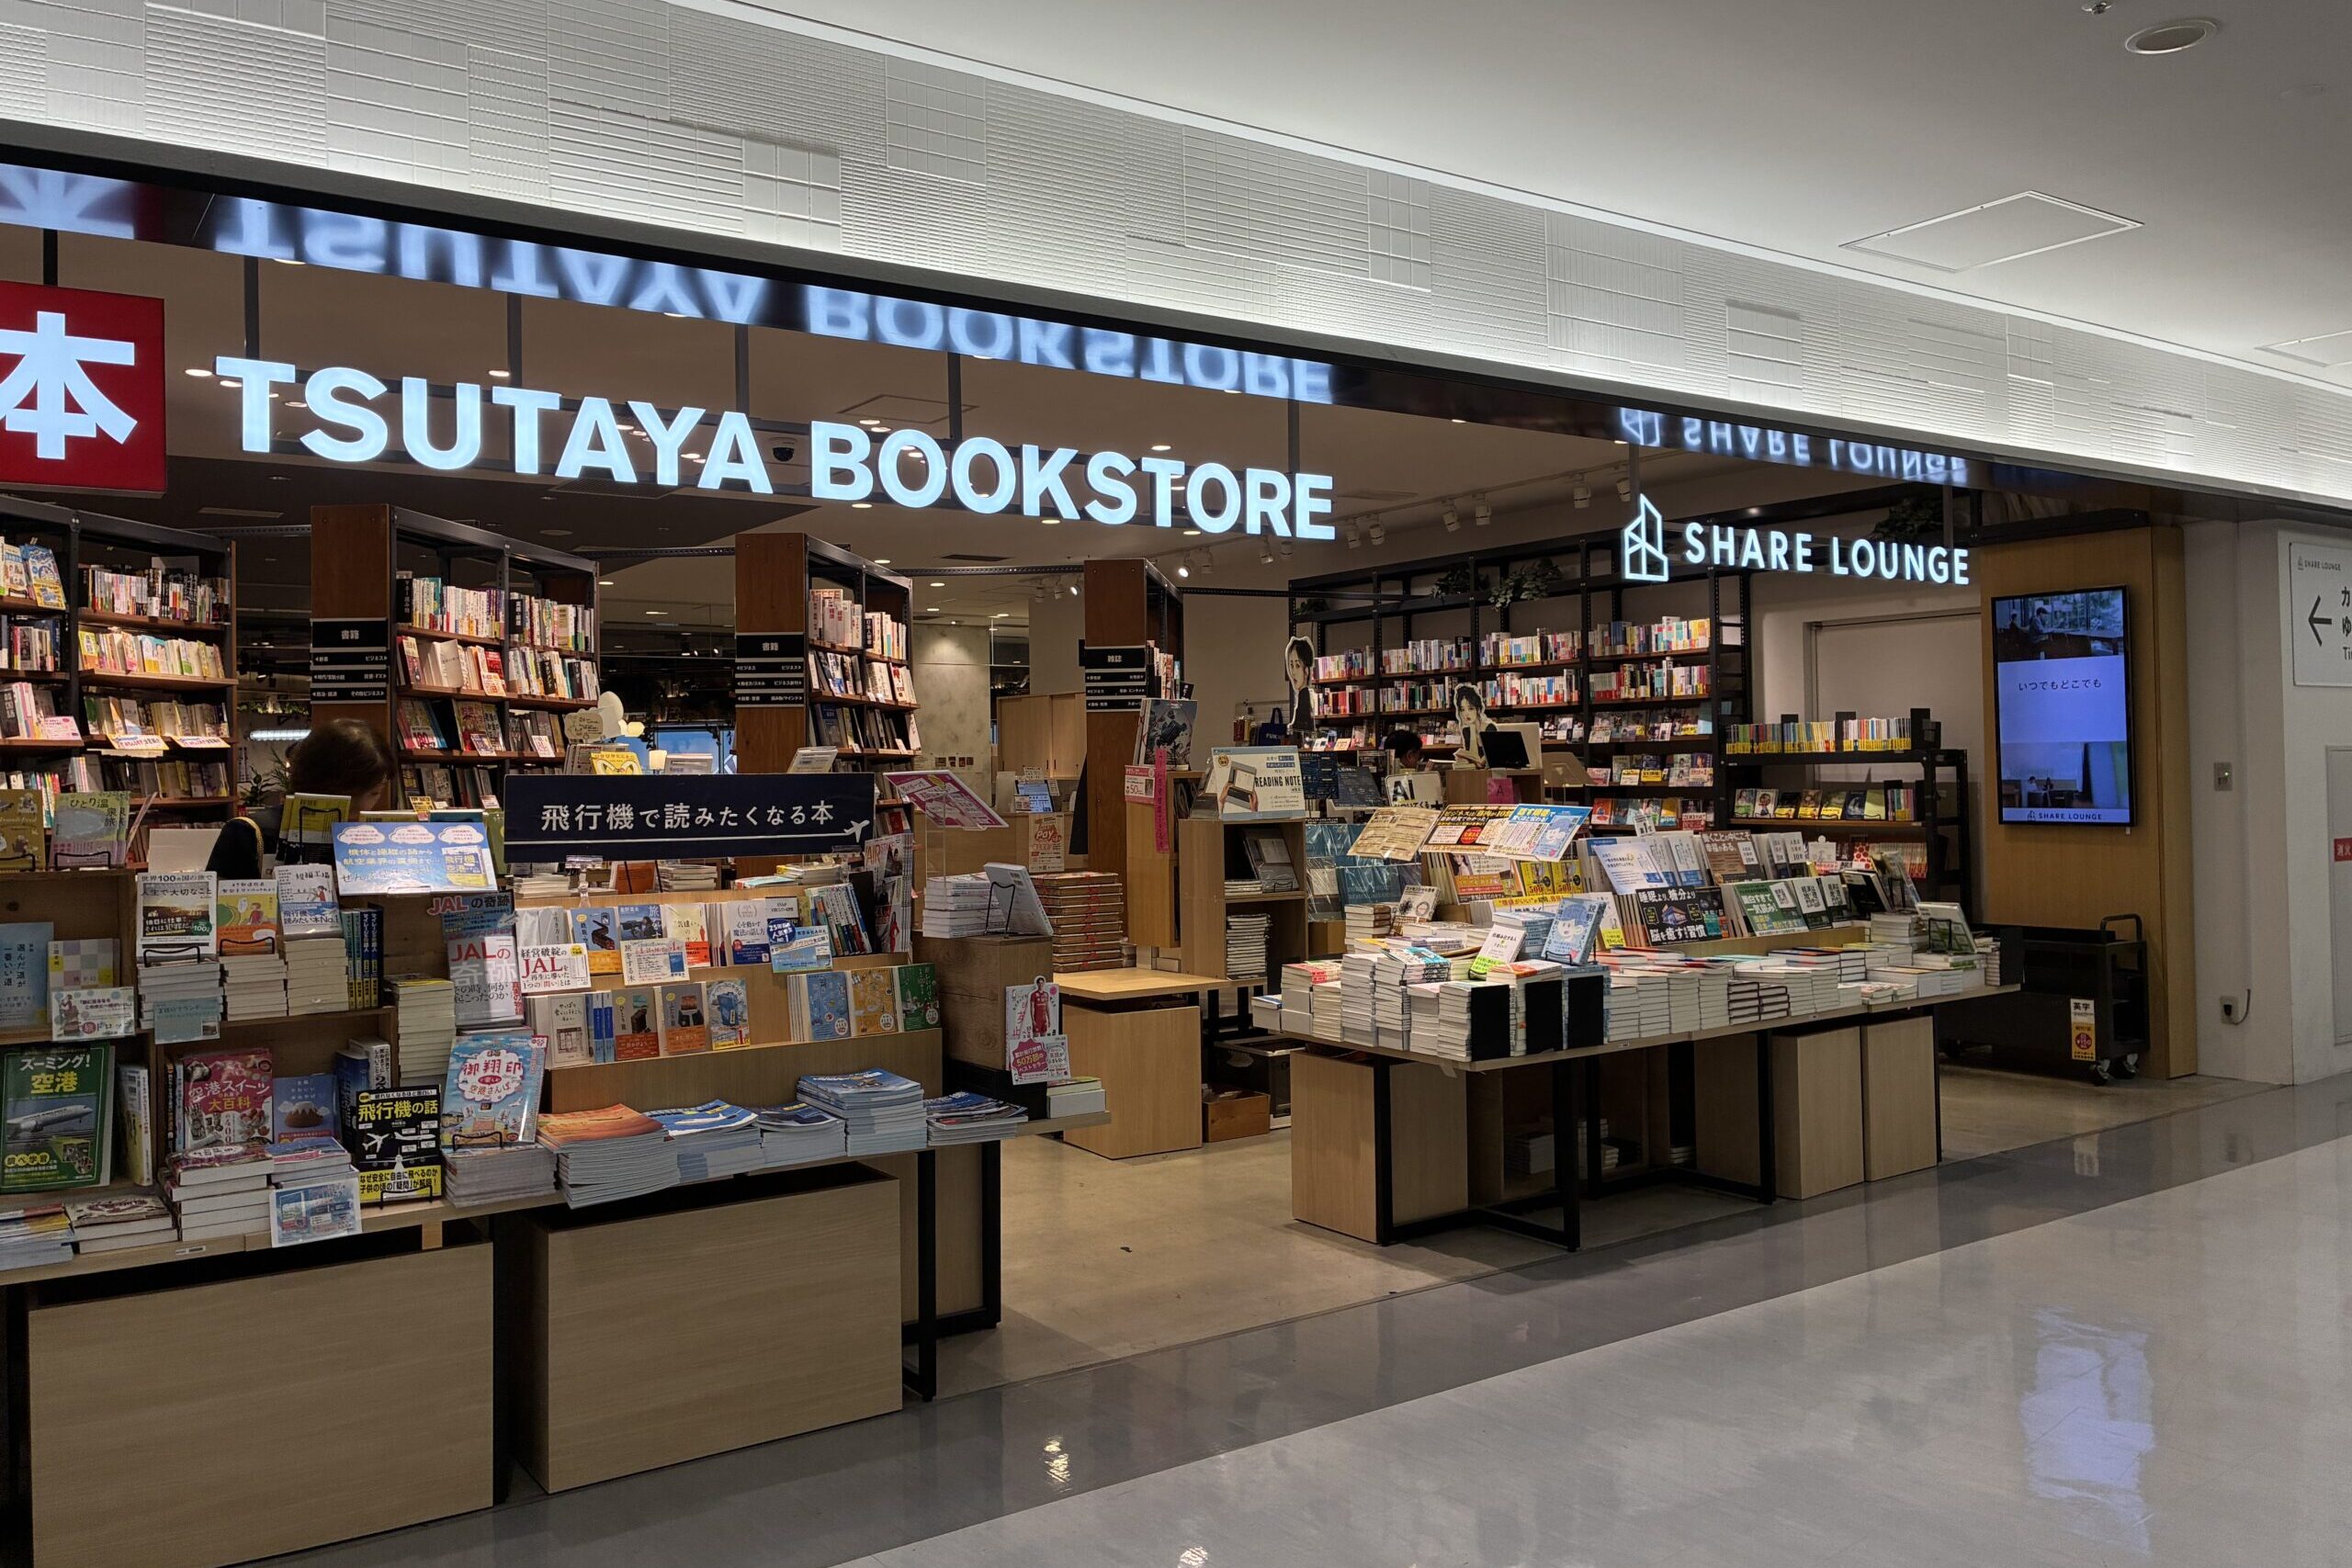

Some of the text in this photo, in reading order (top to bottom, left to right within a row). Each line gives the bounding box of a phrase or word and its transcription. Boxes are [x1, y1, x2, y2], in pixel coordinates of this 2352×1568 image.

[0, 310, 138, 459] 本
[215, 355, 1336, 541] TSUTAYA BOOKSTORE
[1684, 521, 1970, 586] SHARE LOUNGE
[2304, 559, 2342, 571] SHARE LOUNGE
[2018, 678, 2102, 692] いつでもどこでも
[1255, 775, 1302, 788] READING NOTE
[540, 799, 834, 832] 飛行機で読みたくなる本
[2038, 812, 2065, 820] SHARE
[141, 888, 212, 897] 人生で大切なこと
[1637, 887, 1696, 903] 睡眠より、糖分より
[1649, 924, 1707, 942] 脳を癒す!習慣
[450, 941, 511, 963] JALの
[521, 946, 568, 959] 経営破綻の
[17, 943, 26, 987] 選んだ道が
[522, 956, 570, 979] JALを
[625, 943, 636, 982] 旅をする木
[463, 1059, 522, 1076] 御翔印
[30, 1071, 78, 1094] 空港
[187, 1079, 271, 1103] 空港スイーツ
[208, 1095, 251, 1111] 大百科
[358, 1100, 438, 1122] 飛行機の話
[359, 1168, 438, 1183] なぜ安全に自由に飛べるのか
